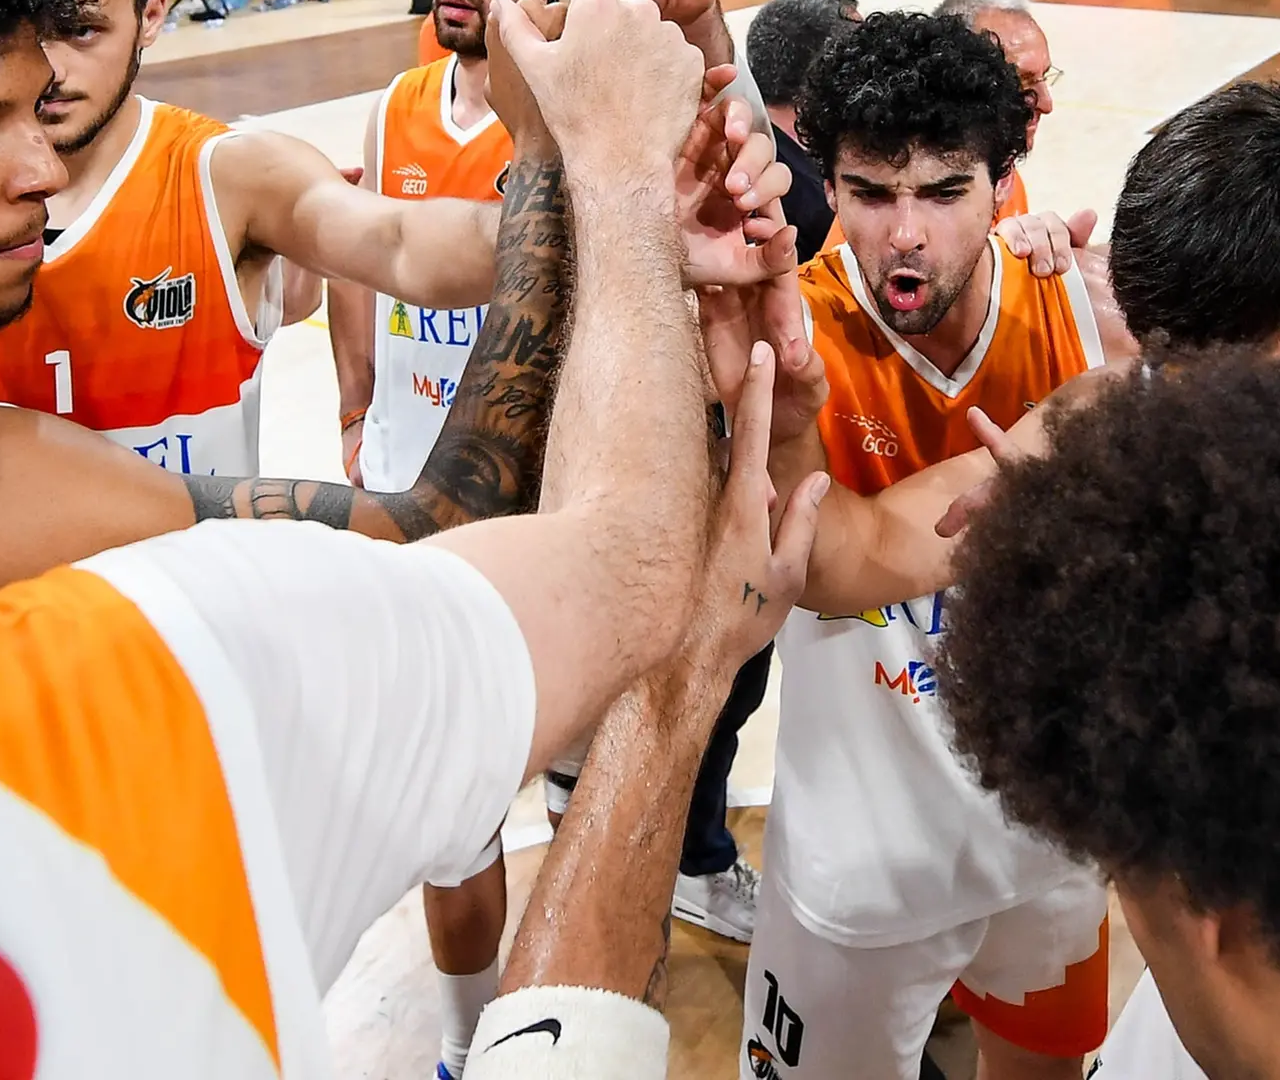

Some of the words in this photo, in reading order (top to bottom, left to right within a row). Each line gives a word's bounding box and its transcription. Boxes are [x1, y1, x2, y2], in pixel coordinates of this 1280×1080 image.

[401, 178, 427, 195] GECO
[45, 350, 73, 414] 1
[761, 968, 805, 1068] 10
